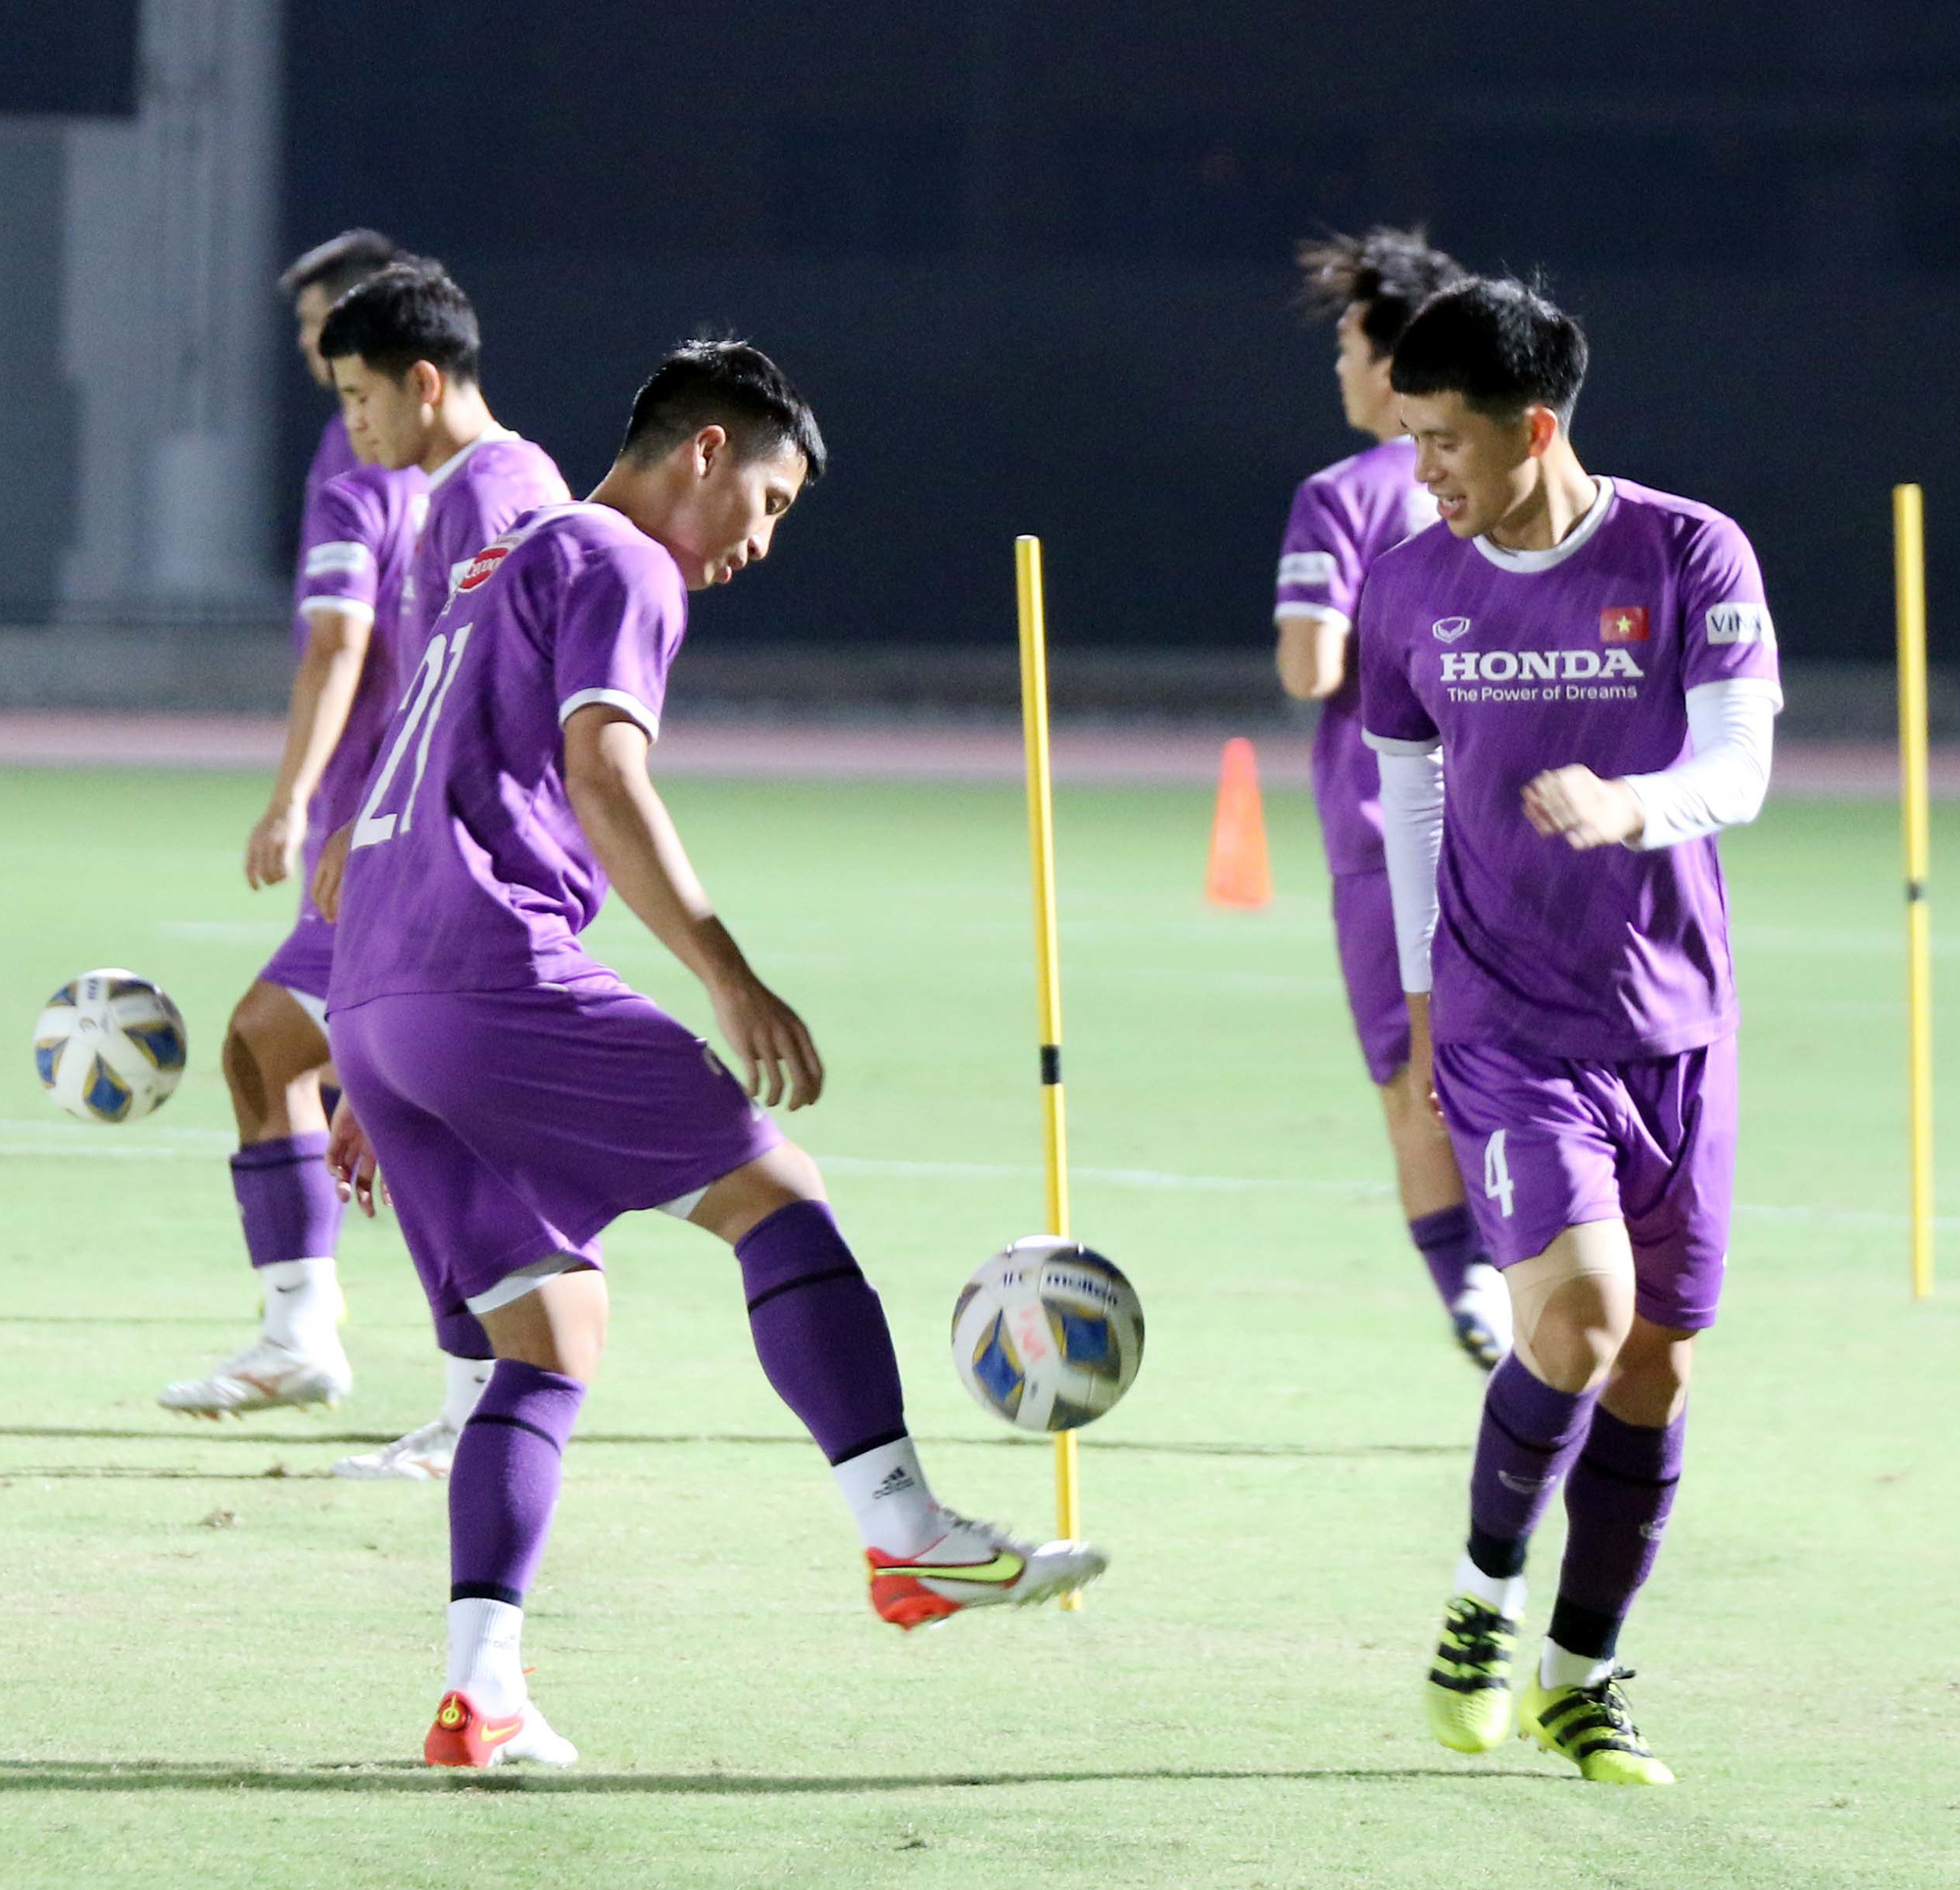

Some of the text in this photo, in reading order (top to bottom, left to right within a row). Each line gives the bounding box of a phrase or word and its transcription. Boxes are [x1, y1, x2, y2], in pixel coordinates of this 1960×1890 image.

[1440, 648, 1644, 682] HONDA
[1446, 685, 1638, 703] The Power of Dreams
[350, 623, 473, 850] 21
[1484, 1128, 1514, 1218] 4
